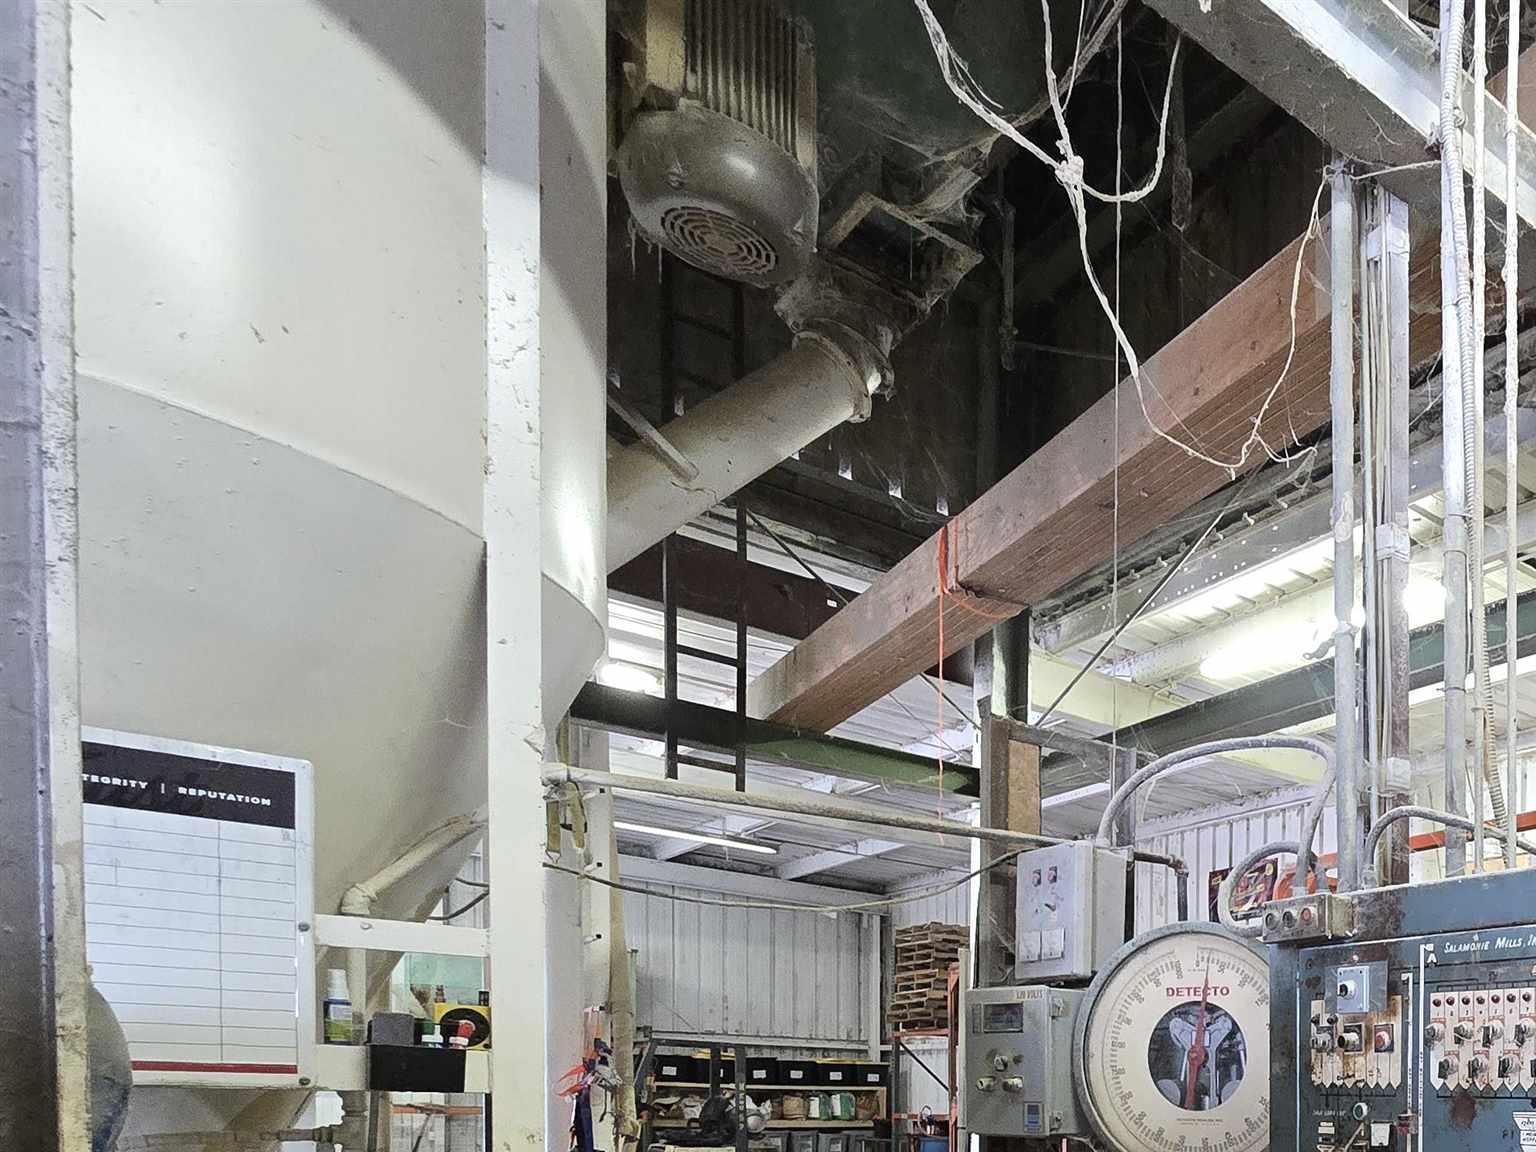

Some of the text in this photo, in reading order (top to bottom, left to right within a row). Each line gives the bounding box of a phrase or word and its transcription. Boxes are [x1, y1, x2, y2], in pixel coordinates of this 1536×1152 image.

[81, 773, 272, 806] TEGRITY REPUTATION
[1166, 986, 1230, 997] DETECTO
